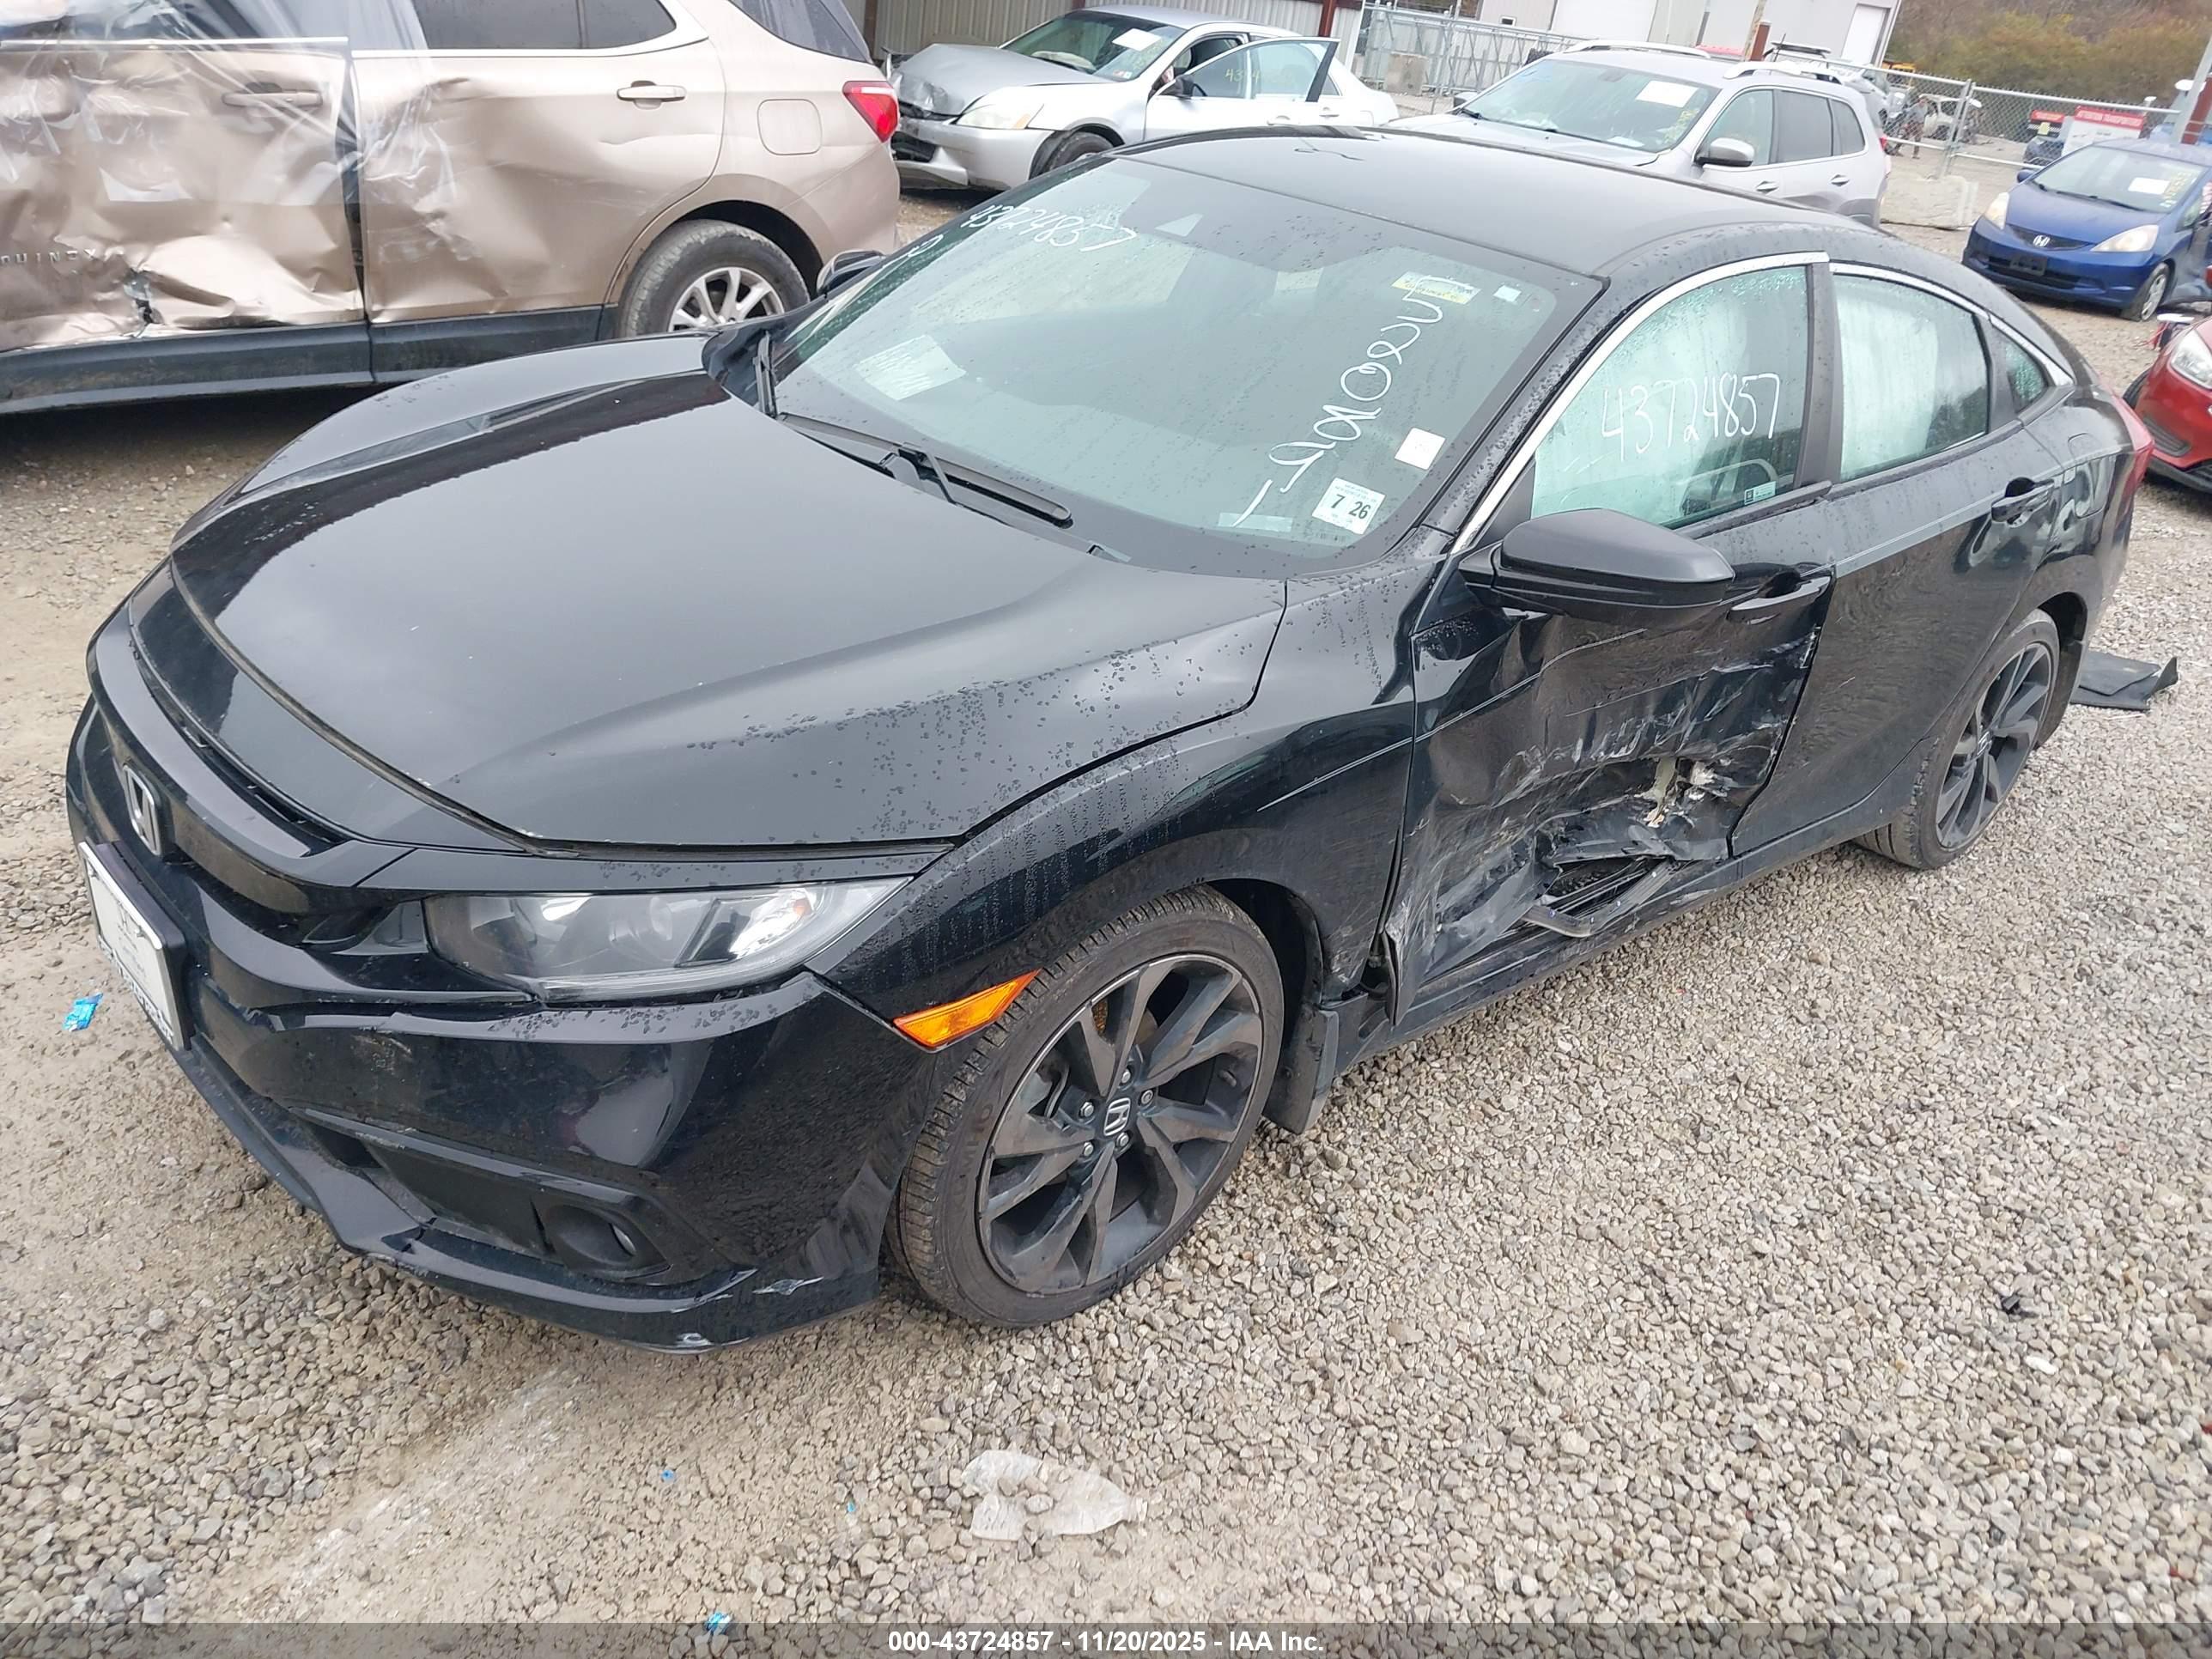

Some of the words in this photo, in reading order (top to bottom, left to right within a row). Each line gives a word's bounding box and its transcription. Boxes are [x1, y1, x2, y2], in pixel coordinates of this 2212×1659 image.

[960, 204, 1137, 252] 43724857
[1601, 372, 1781, 462] 43724857
[1330, 494, 1346, 509] 7
[1347, 501, 1371, 520] 26
